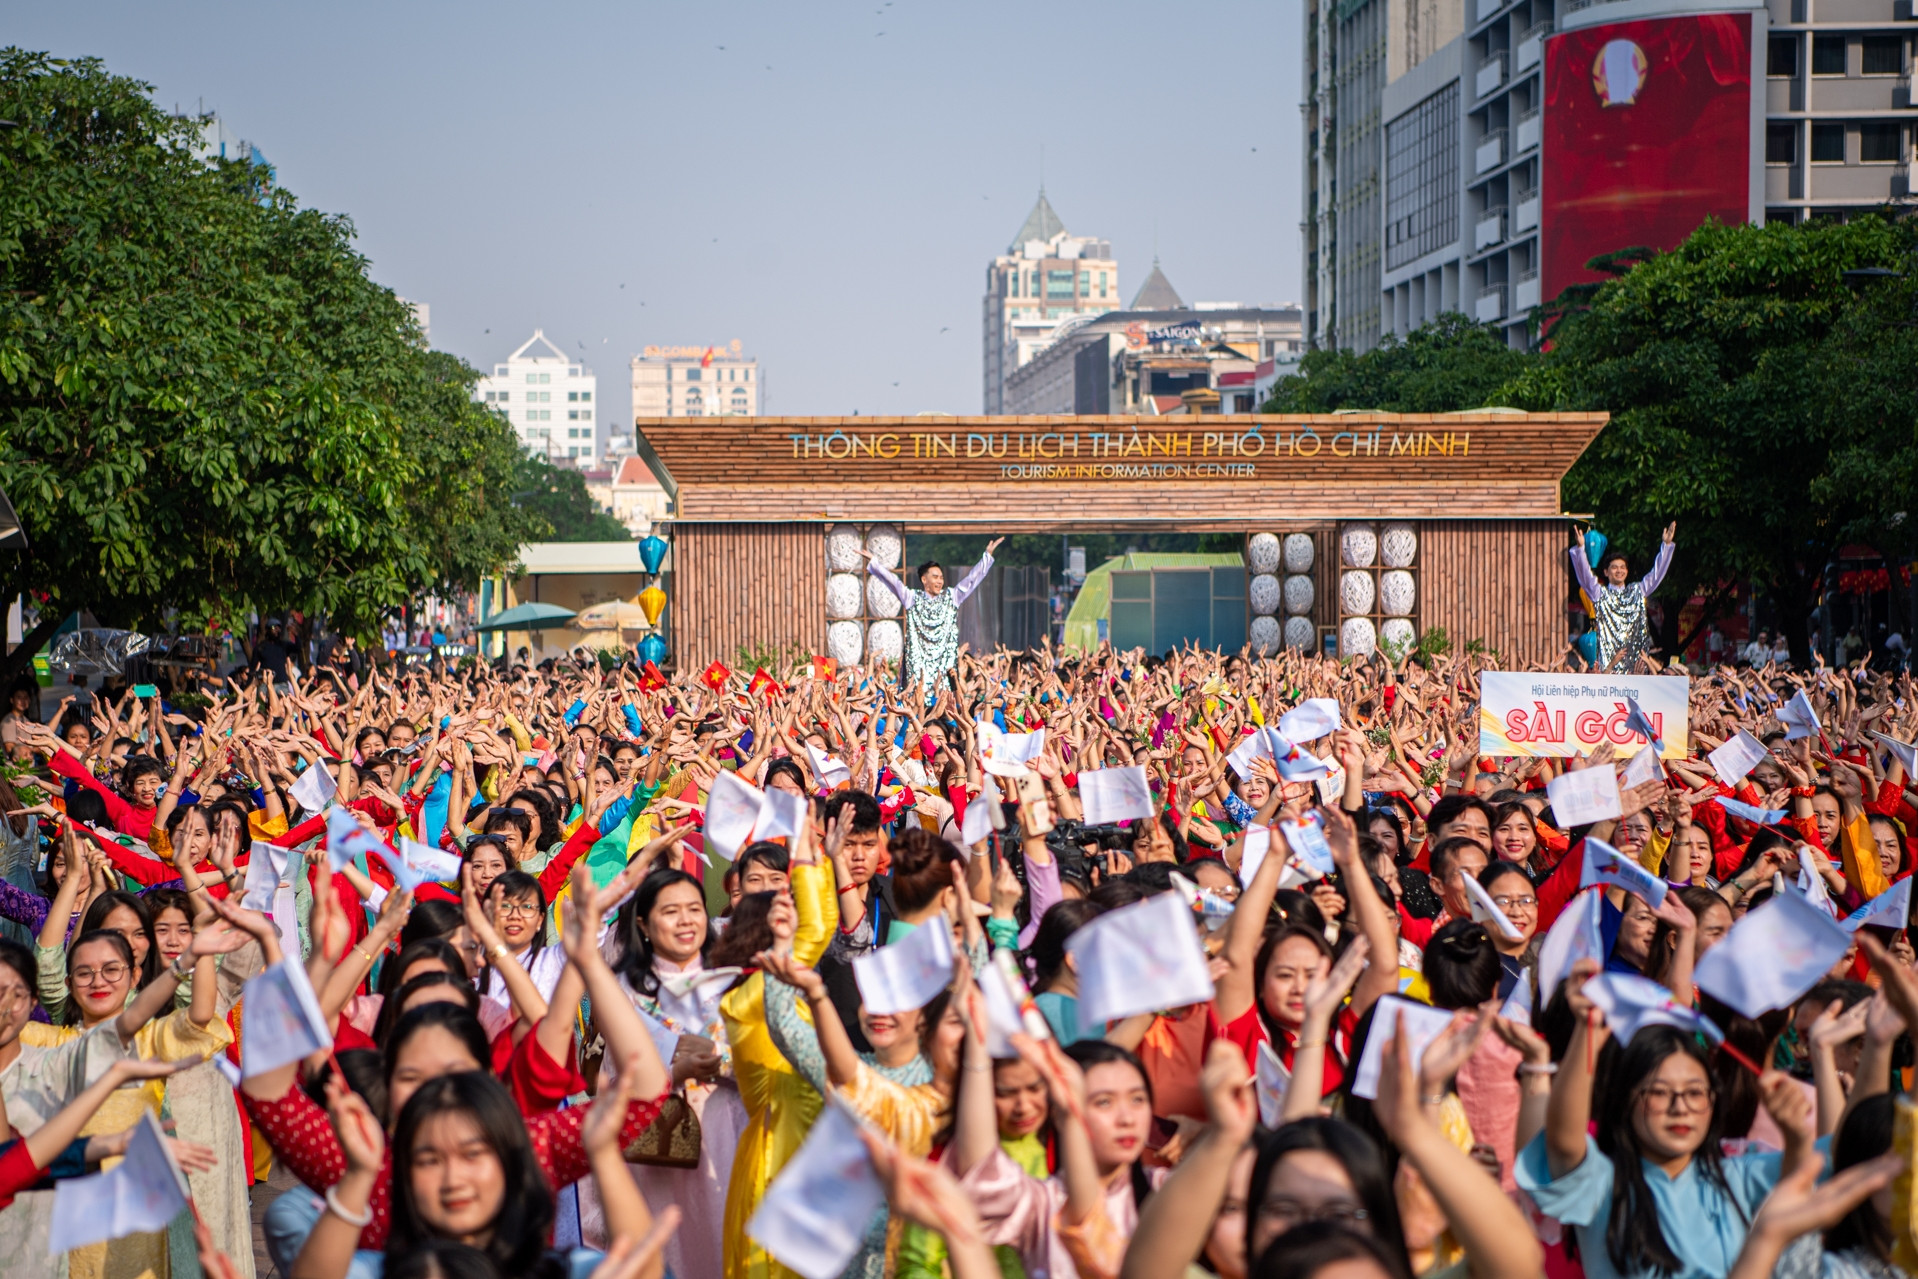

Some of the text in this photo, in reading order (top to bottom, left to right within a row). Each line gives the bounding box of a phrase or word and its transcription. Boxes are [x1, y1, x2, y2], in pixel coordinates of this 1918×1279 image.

[789, 424, 1470, 462] THÔNG TIN DU LỊCH THÀNH PHỐ HỒ CHÍ MINH
[1000, 463, 1256, 479] TOURISM INFORMATION CENTER
[1531, 684, 1639, 700] Hội Liên hiệp Phụ nữ Phường
[1505, 701, 1566, 743] SÀI
